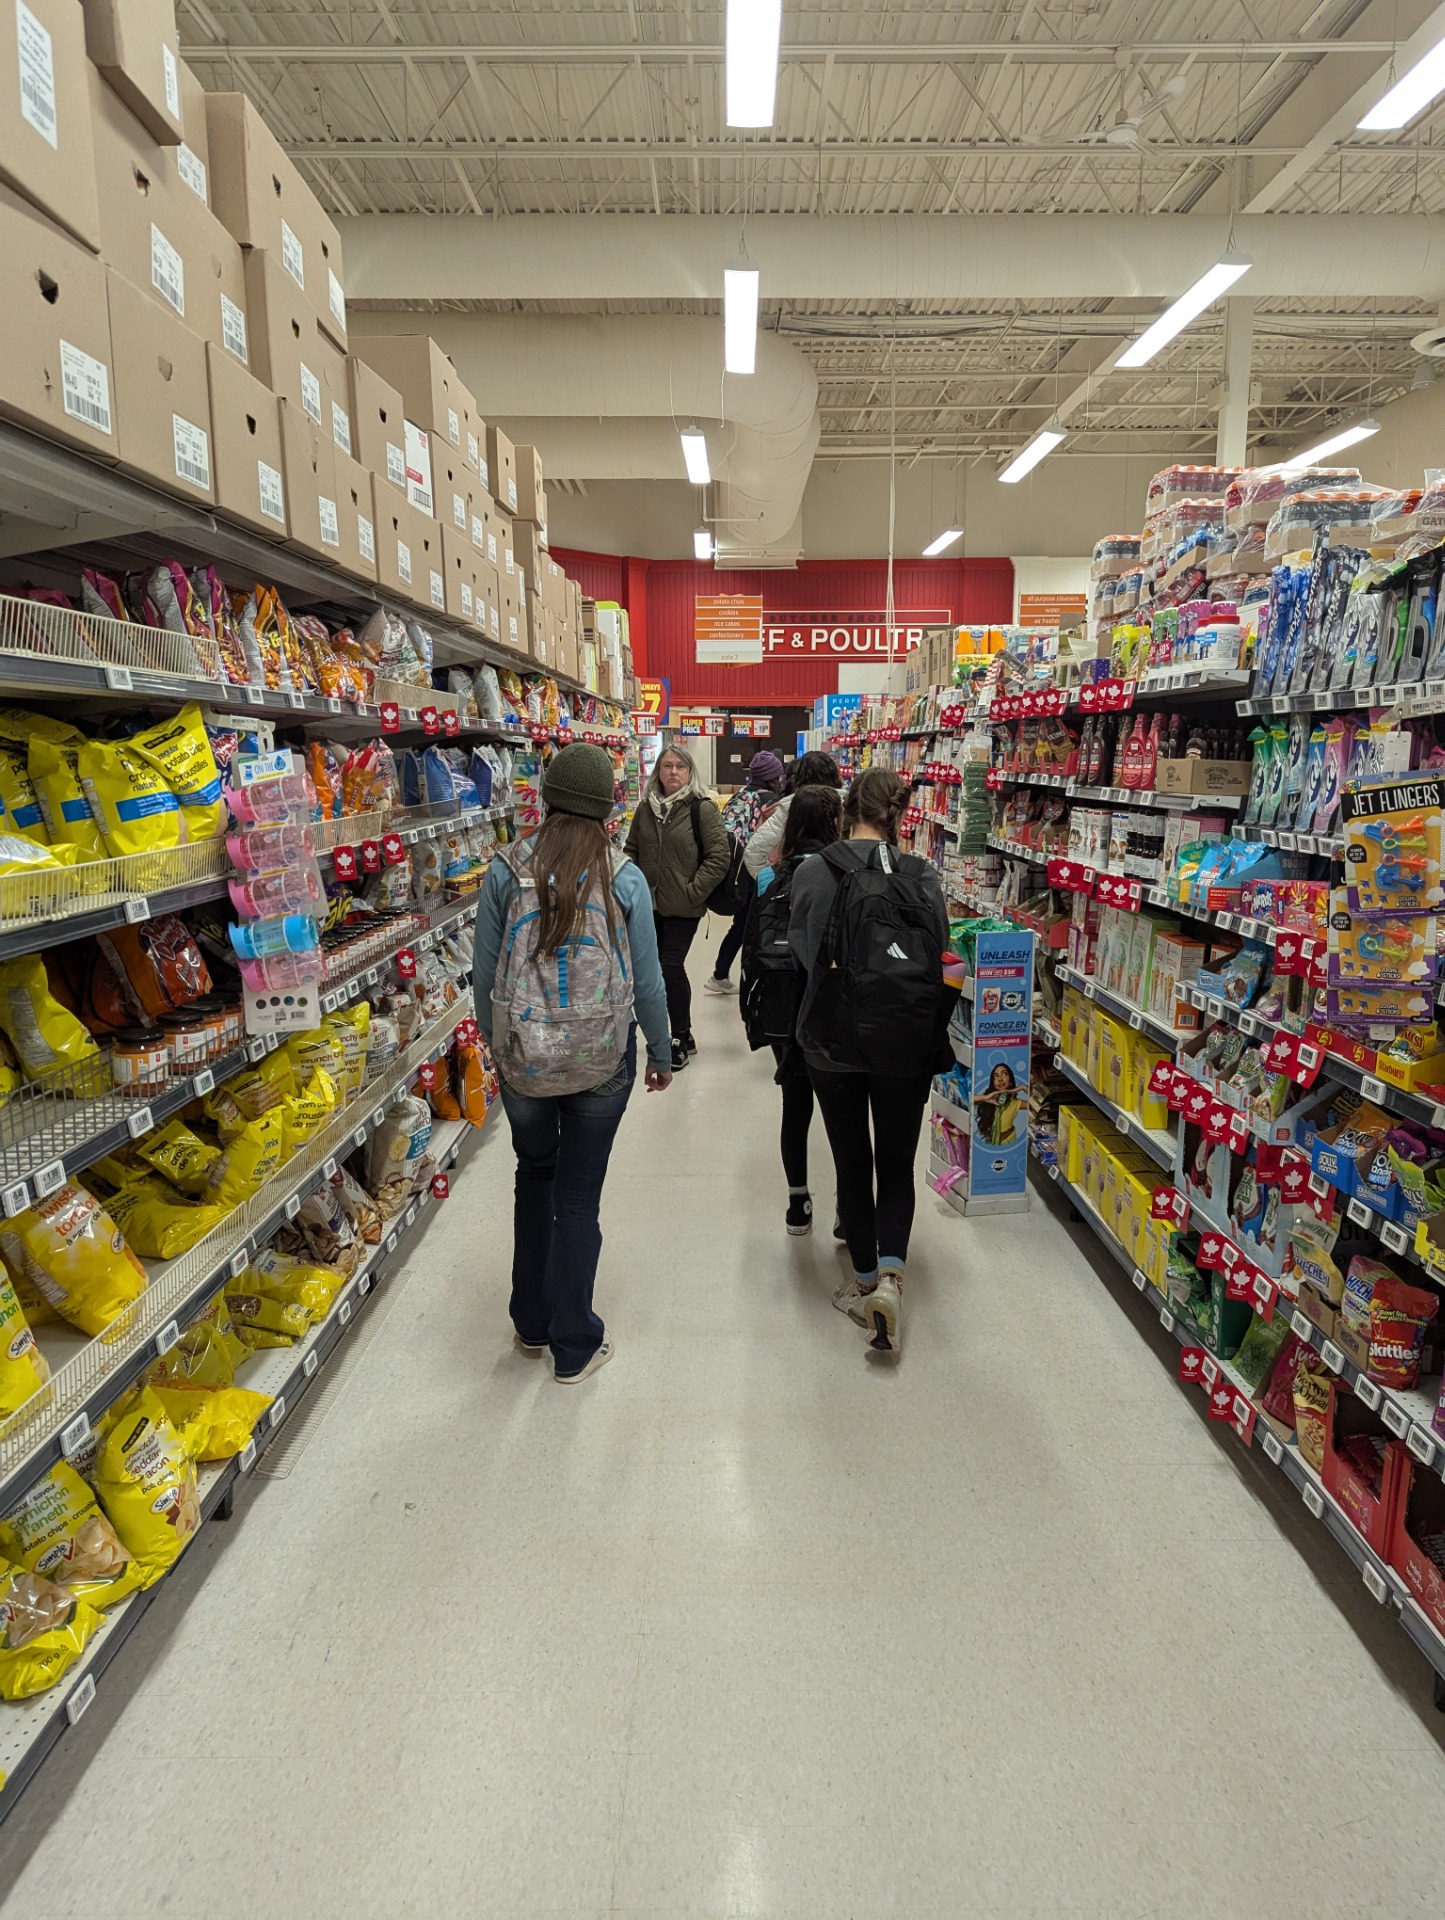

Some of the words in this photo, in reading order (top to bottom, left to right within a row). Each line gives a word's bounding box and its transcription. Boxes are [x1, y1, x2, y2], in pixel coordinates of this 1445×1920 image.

[791, 632, 805, 648] &
[682, 719, 702, 727] SUPER
[682, 726, 701, 734] PRICE
[734, 720, 752, 728] SUPER
[734, 727, 750, 735] PRICE
[158, 744, 180, 760] regular
[164, 751, 190, 772] potato
[254, 764, 265, 775] ON
[265, 762, 275, 773] THE
[173, 759, 209, 783] croustilles
[1352, 793, 1374, 816] JET
[1379, 783, 1440, 812] FLINGERS
[1253, 891, 1273, 909] Nerds
[980, 950, 1030, 960] UNLEASH
[979, 1021, 1013, 1030] FONCEZ
[1016, 1020, 1028, 1028] EN
[1378, 1060, 1405, 1080] Starburst
[1343, 1128, 1373, 1144] JOLLY
[1320, 1153, 1338, 1168] JOLLY
[38, 1186, 78, 1220] twists
[22, 1301, 34, 1310] 200
[1369, 1342, 1420, 1360] Skittles
[1300, 1386, 1328, 1411] Original
[29, 1483, 57, 1504] saveur
[8, 1485, 71, 1532] cornichon
[24, 1503, 69, 1541] l'aneth
[21, 1536, 47, 1556] potato
[47, 1520, 69, 1541] chips
[38, 1543, 68, 1570] Simple
